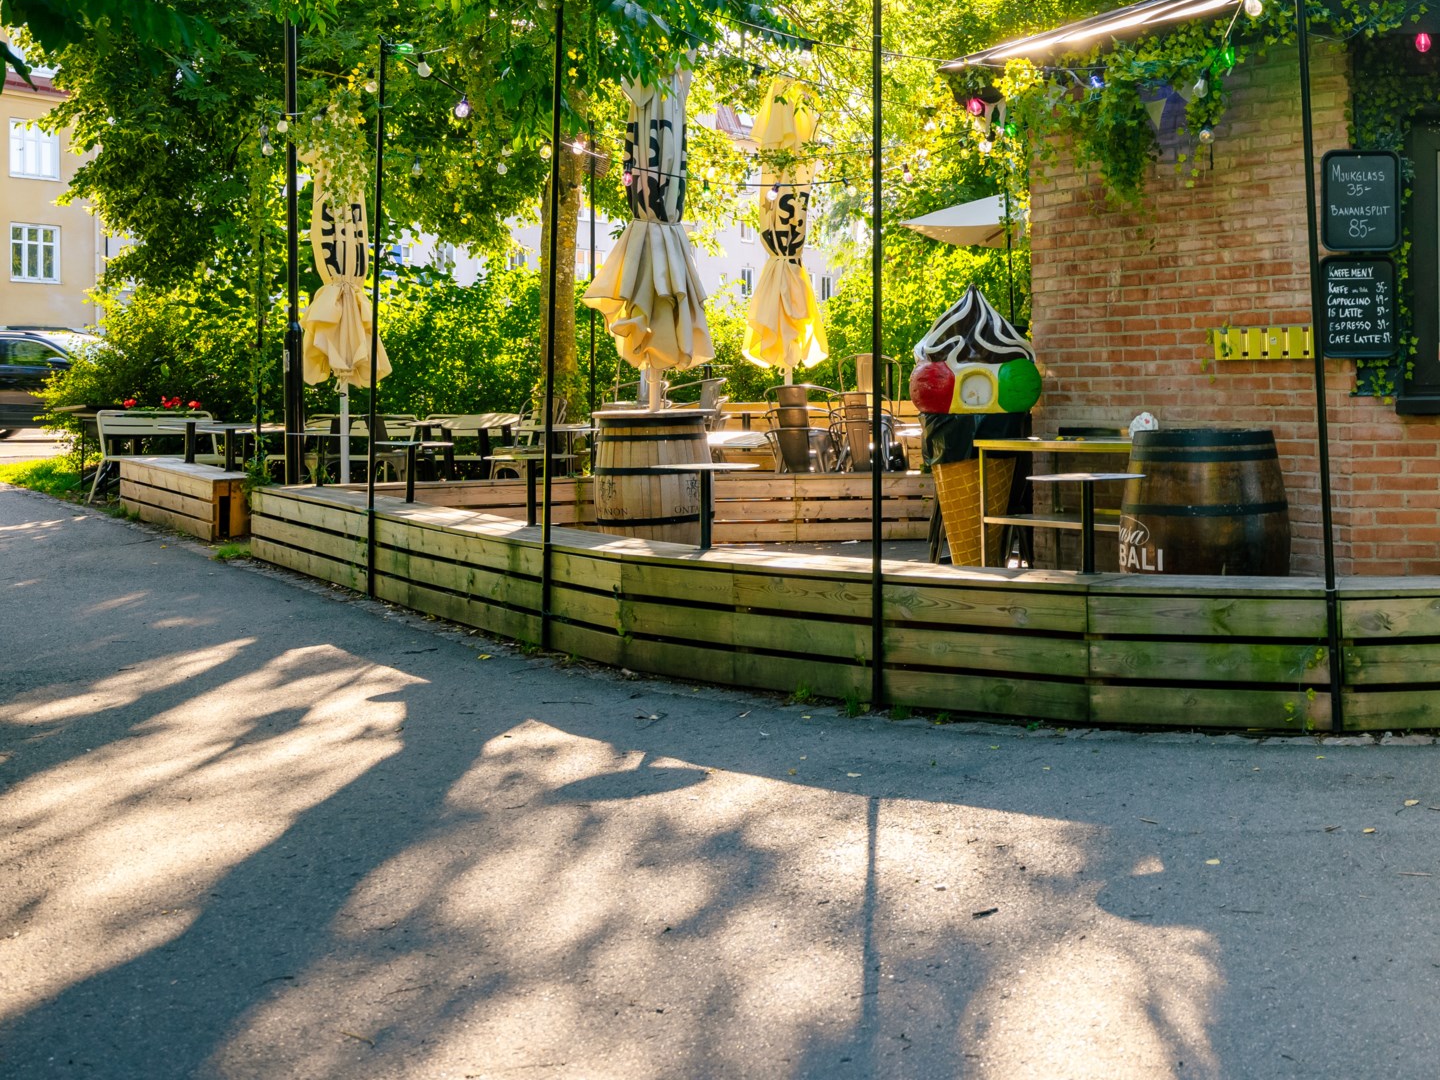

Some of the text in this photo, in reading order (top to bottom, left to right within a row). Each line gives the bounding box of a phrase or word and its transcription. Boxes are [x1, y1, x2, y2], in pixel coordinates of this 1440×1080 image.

[1330, 204, 1391, 216] BANANASPLIT
[1328, 266, 1374, 277] KAFFE MENY
[1328, 282, 1349, 294] KAFFE
[1327, 294, 1371, 306] CAPPUCCINO
[1339, 307, 1364, 318] LATTE
[1329, 320, 1371, 331] ESPRESSO
[1329, 333, 1351, 344] CAFE
[1354, 333, 1382, 344] LATTE
[1119, 543, 1164, 572] BALI
